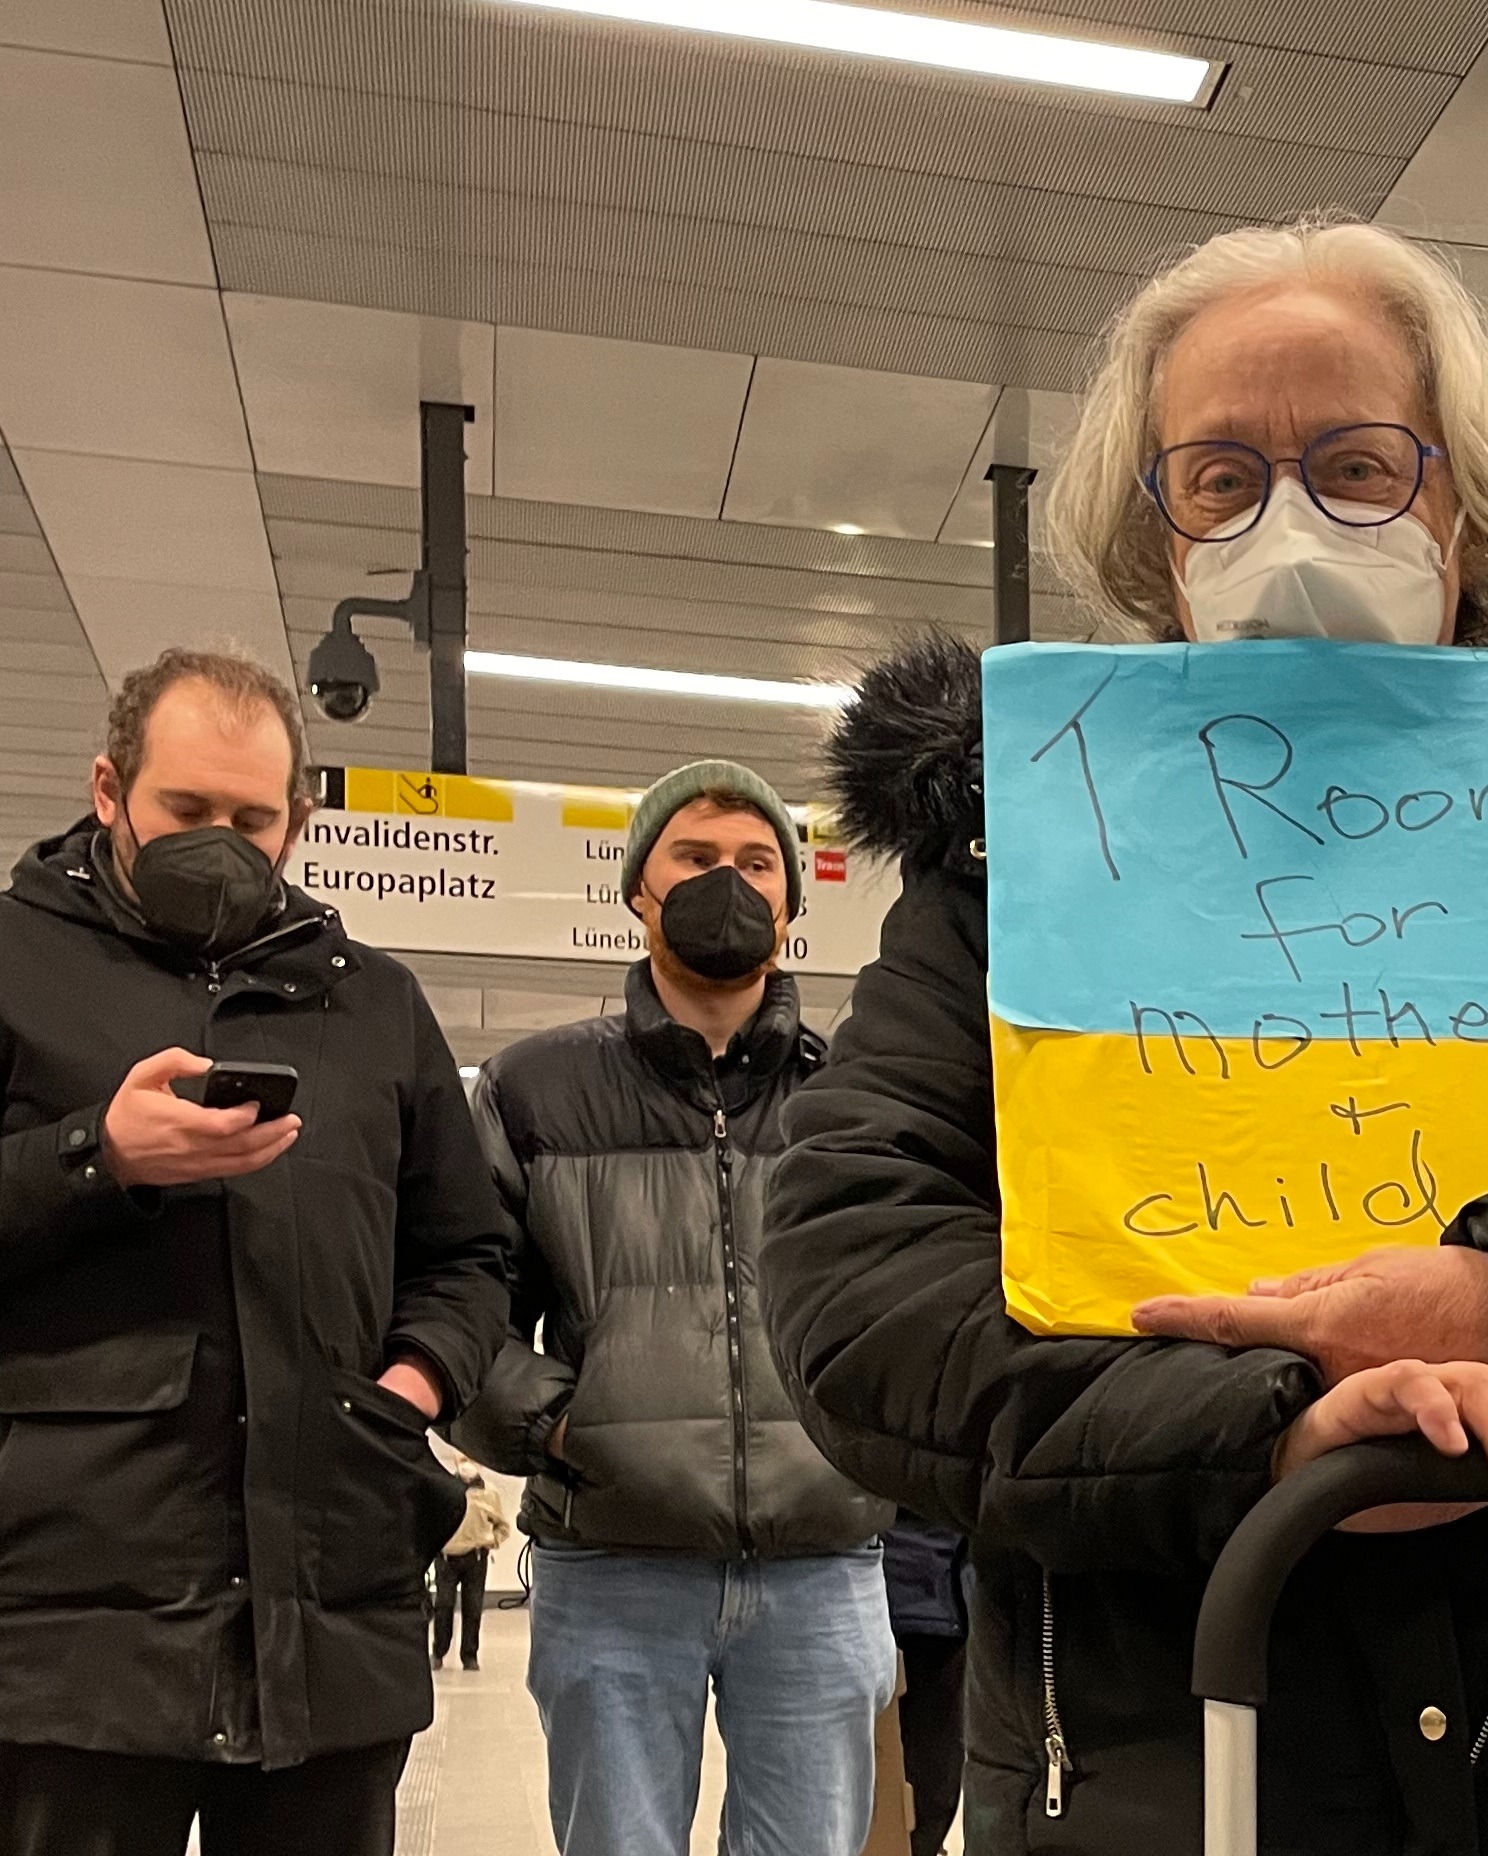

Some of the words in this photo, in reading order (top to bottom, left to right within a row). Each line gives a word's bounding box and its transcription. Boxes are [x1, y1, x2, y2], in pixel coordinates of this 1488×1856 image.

[304, 819, 499, 856] Invalidenstr.
[303, 861, 496, 902] Europaplatz
[1123, 1129, 1448, 1238] child
